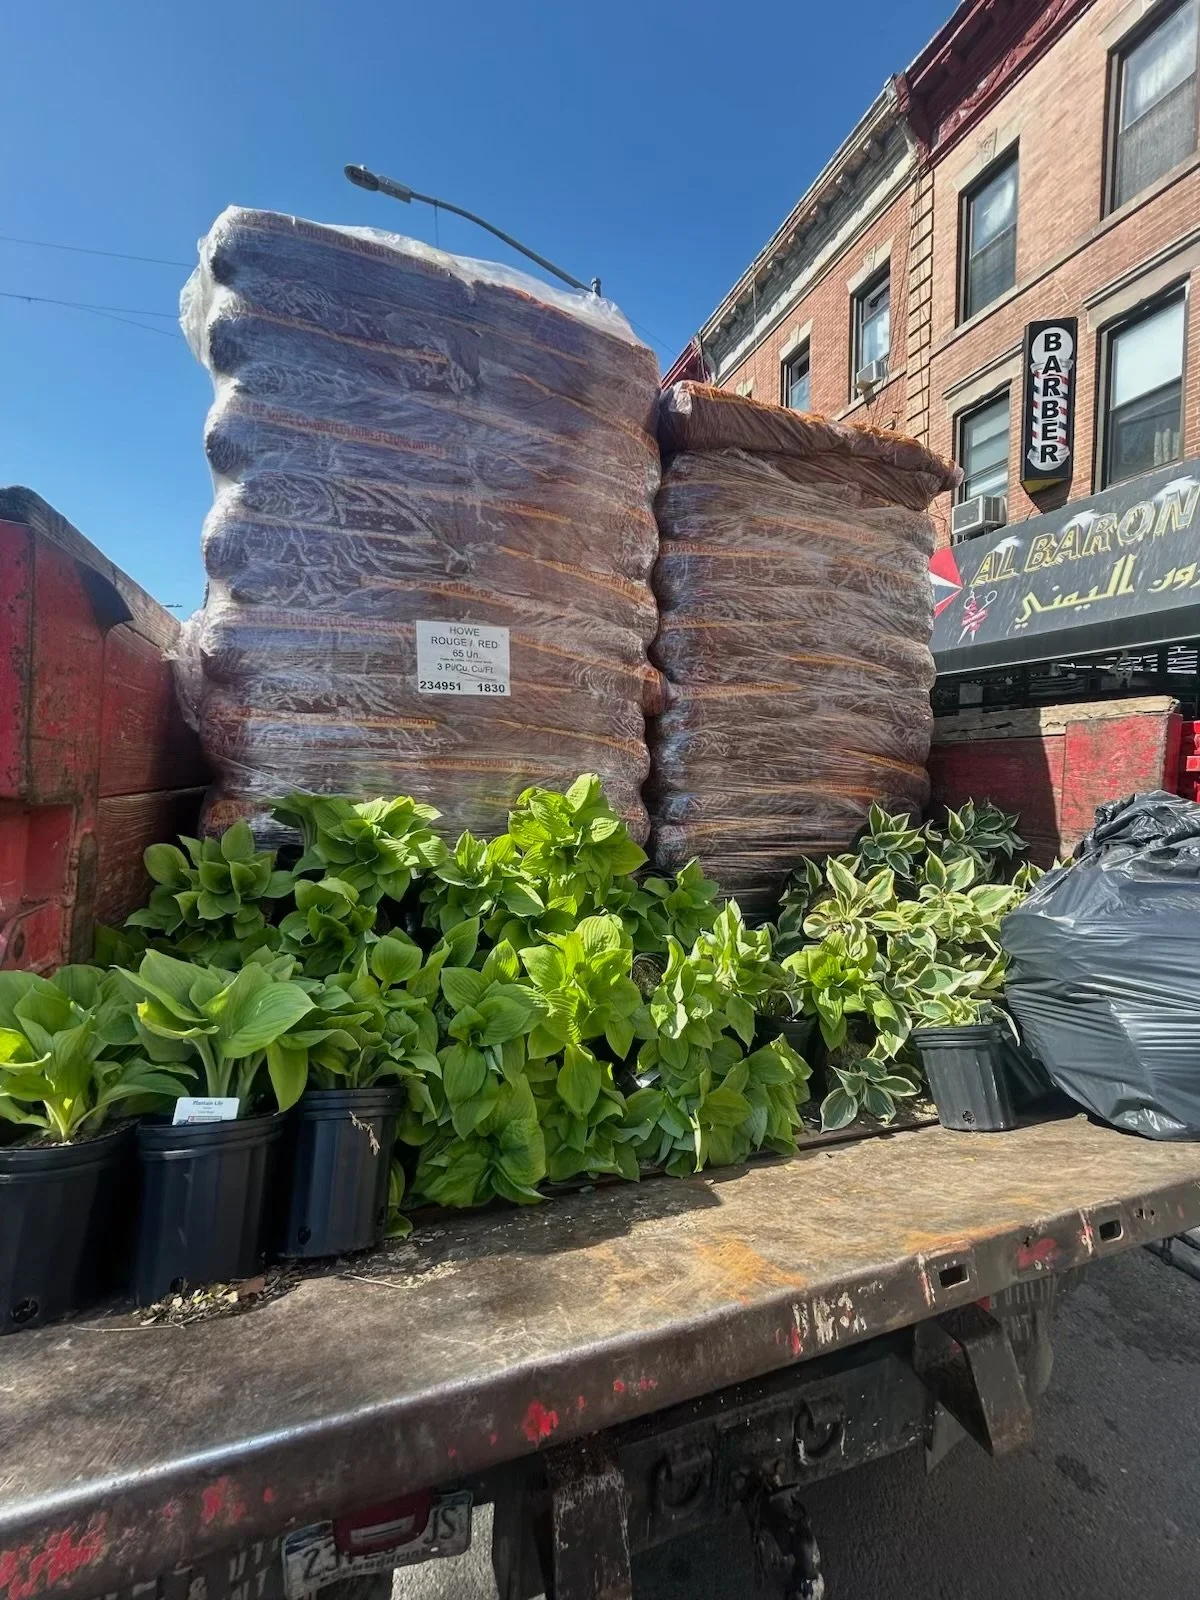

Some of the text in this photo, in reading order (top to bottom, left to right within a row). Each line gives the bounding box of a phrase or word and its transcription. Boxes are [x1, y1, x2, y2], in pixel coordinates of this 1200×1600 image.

[1040, 332, 1063, 464] BARBER
[967, 484, 1200, 588] AL BARON
[449, 626, 480, 637] HOWE
[478, 639, 498, 649] RED
[452, 649, 464, 658] 65
[437, 662, 443, 671] 3
[420, 680, 505, 693] 234951 1830
